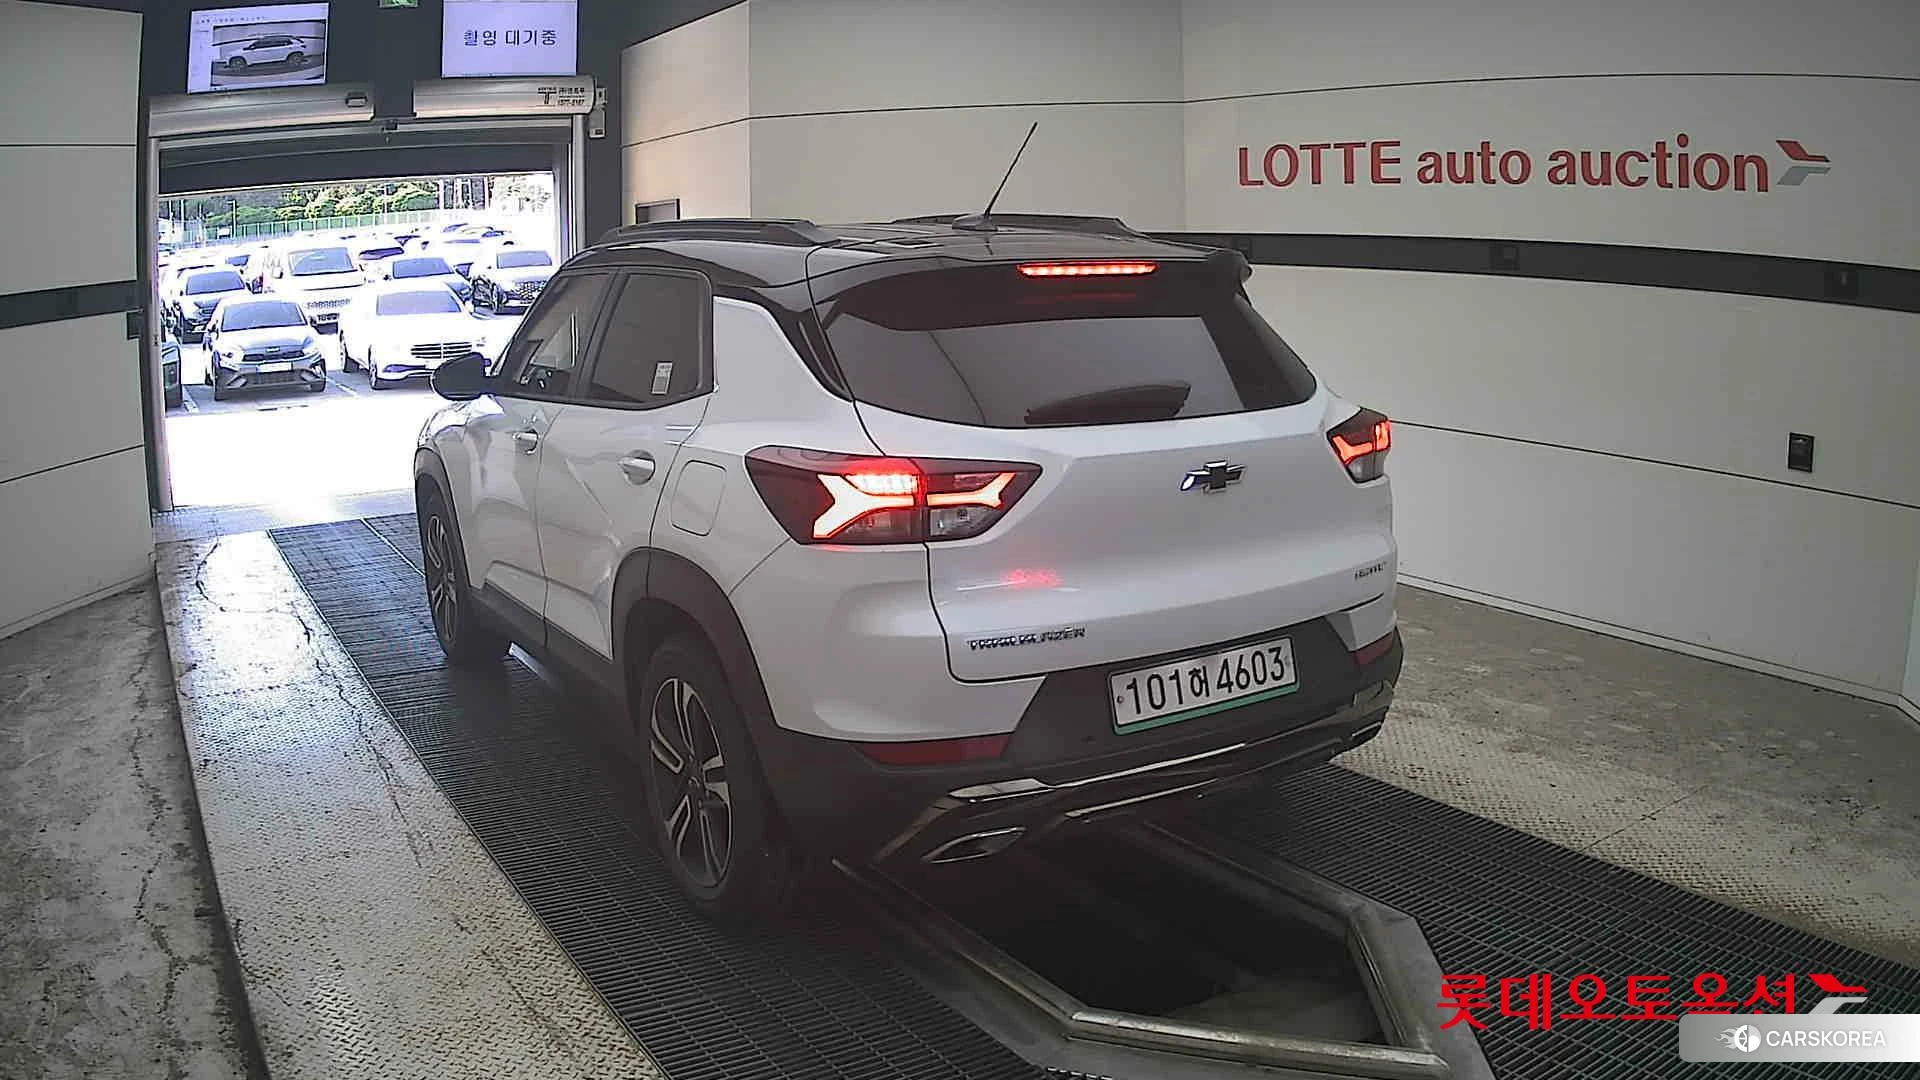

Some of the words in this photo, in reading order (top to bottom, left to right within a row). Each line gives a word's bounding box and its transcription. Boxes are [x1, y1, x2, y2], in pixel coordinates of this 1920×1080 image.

[505, 29, 557, 46] 대기중
[1239, 140, 1401, 187] LOTTE
[1416, 140, 1531, 185] auto
[1547, 133, 1769, 193] auction
[1126, 646, 1285, 715] 101허4603
